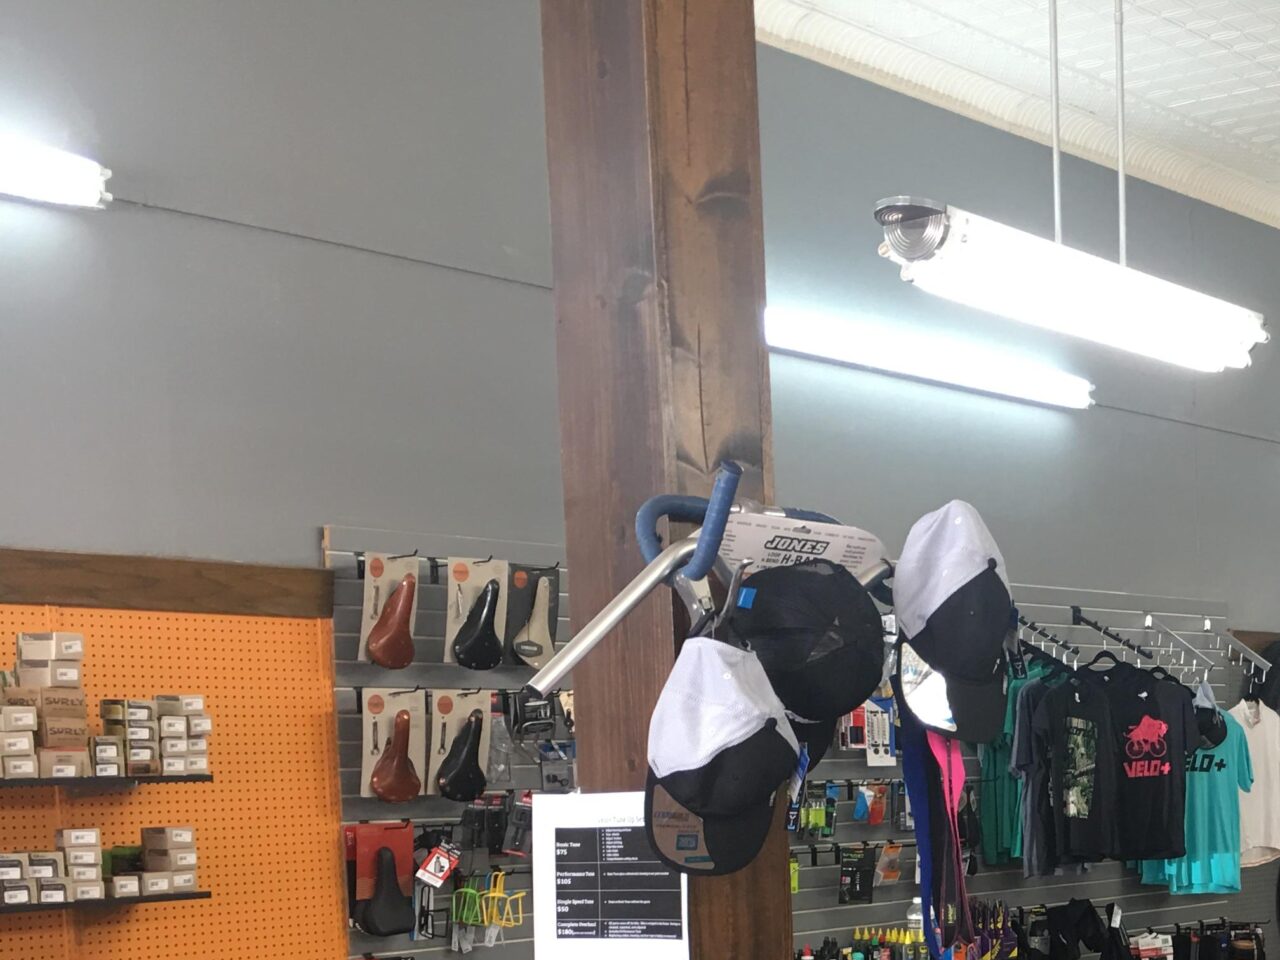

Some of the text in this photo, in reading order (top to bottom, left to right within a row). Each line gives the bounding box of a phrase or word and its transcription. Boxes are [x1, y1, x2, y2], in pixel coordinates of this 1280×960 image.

[764, 535, 830, 555] JONES
[44, 697, 84, 706] SURLY
[49, 727, 87, 735] SURLY
[1123, 760, 1171, 778] VELO+
[1185, 754, 1227, 772] ELO+
